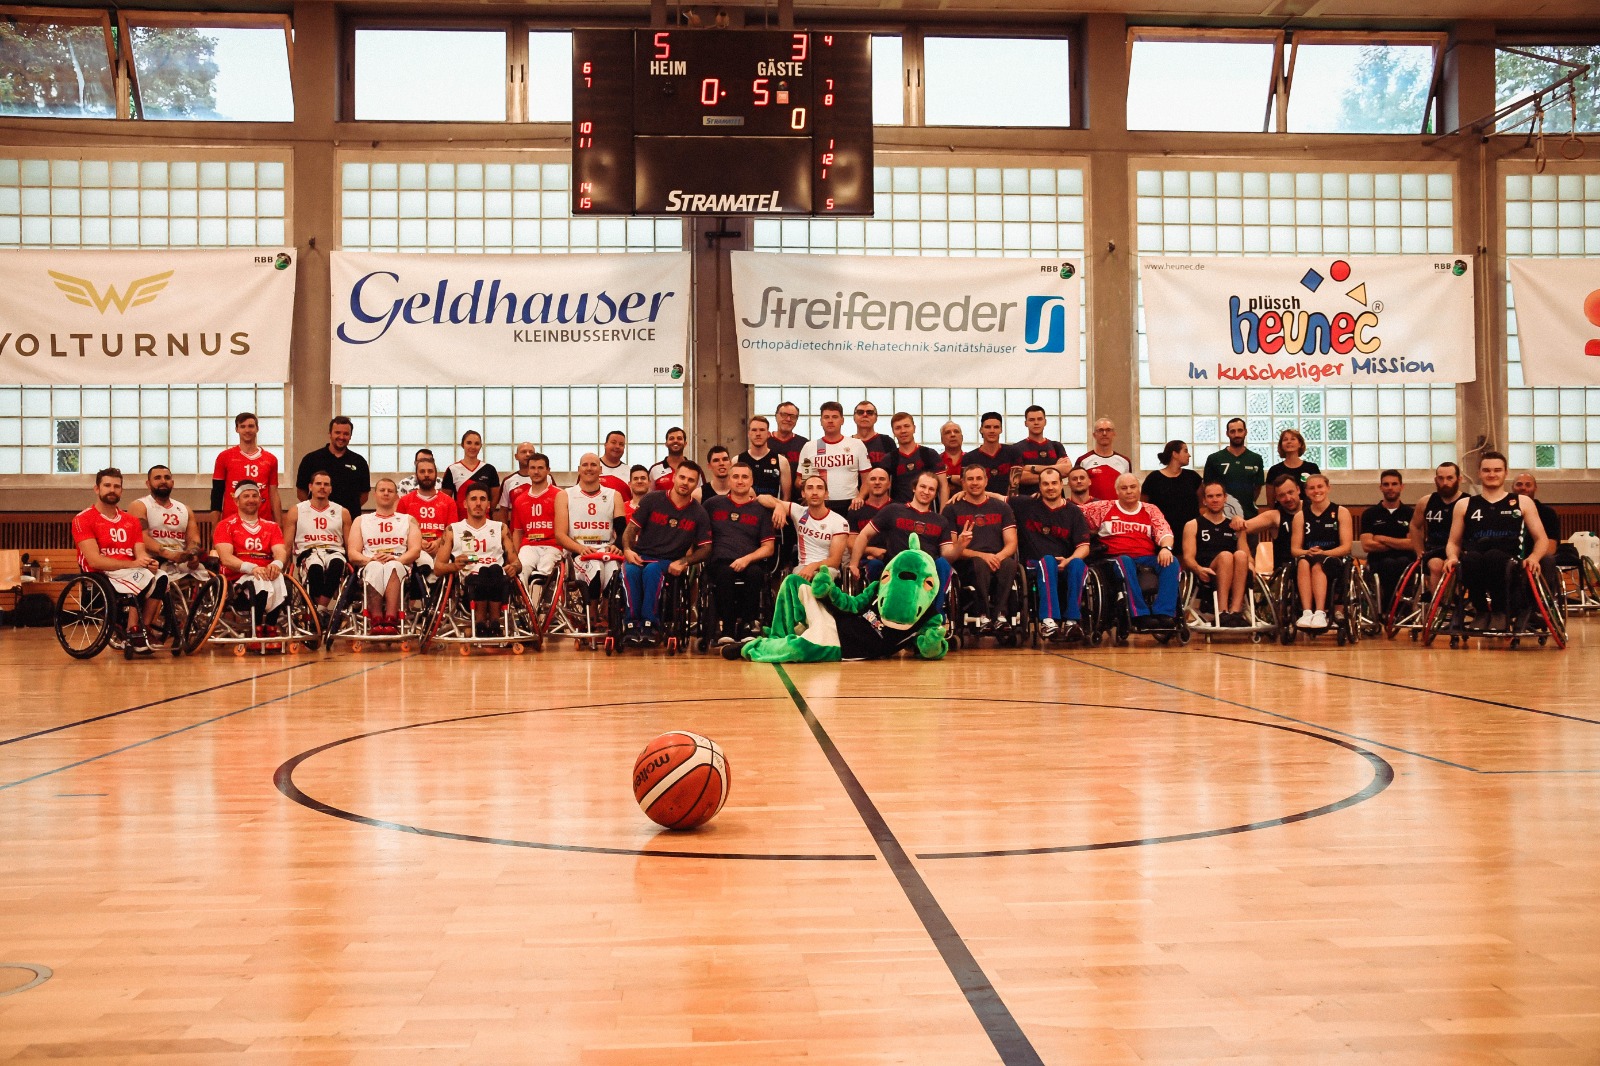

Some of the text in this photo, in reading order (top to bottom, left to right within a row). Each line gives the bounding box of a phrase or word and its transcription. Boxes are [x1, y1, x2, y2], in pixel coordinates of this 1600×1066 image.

[654, 32, 670, 59] 5
[791, 33, 807, 61] 3
[824, 35, 833, 46] 4
[583, 62, 592, 74] 6
[650, 61, 687, 75] HEIM
[757, 59, 804, 76] GÄSTE
[584, 77, 592, 88] 7
[825, 79, 833, 90] 7
[701, 78, 719, 105] 0
[753, 79, 769, 106] 5
[824, 94, 834, 106] 8
[791, 107, 806, 129] 0
[580, 122, 592, 134] 10
[579, 137, 592, 149] 11
[822, 153, 834, 165] 12
[580, 182, 593, 194] 14
[580, 197, 592, 209] 15
[665, 190, 783, 212] STRAMATEL
[1144, 263, 1205, 271] www.heunec.de
[336, 271, 675, 345] Geldhauser
[742, 286, 1018, 333] Streifeneder
[1249, 295, 1301, 311] plüsch
[1229, 295, 1382, 355] heunec
[513, 328, 656, 343] KLEINBUSSERVICE
[1188, 356, 1435, 382] In kuscheliger Mission
[814, 454, 854, 468] RUSSIA
[244, 464, 259, 477] 13
[1220, 463, 1230, 475] 7
[419, 507, 436, 519] 93
[531, 503, 542, 516] 10
[588, 503, 597, 516] 8
[1471, 509, 1483, 521] 4
[162, 513, 180, 526] 23
[1426, 510, 1443, 523] 44
[313, 517, 328, 530] 19
[378, 522, 393, 533] 16
[420, 522, 445, 530] UISSE
[573, 521, 609, 530] SUISSE
[109, 528, 127, 543] 90
[304, 534, 338, 543] SUISSE
[367, 537, 405, 546] SUISSE
[1201, 530, 1211, 541] 5
[245, 538, 262, 551] 66
[100, 547, 133, 557] SUISS
